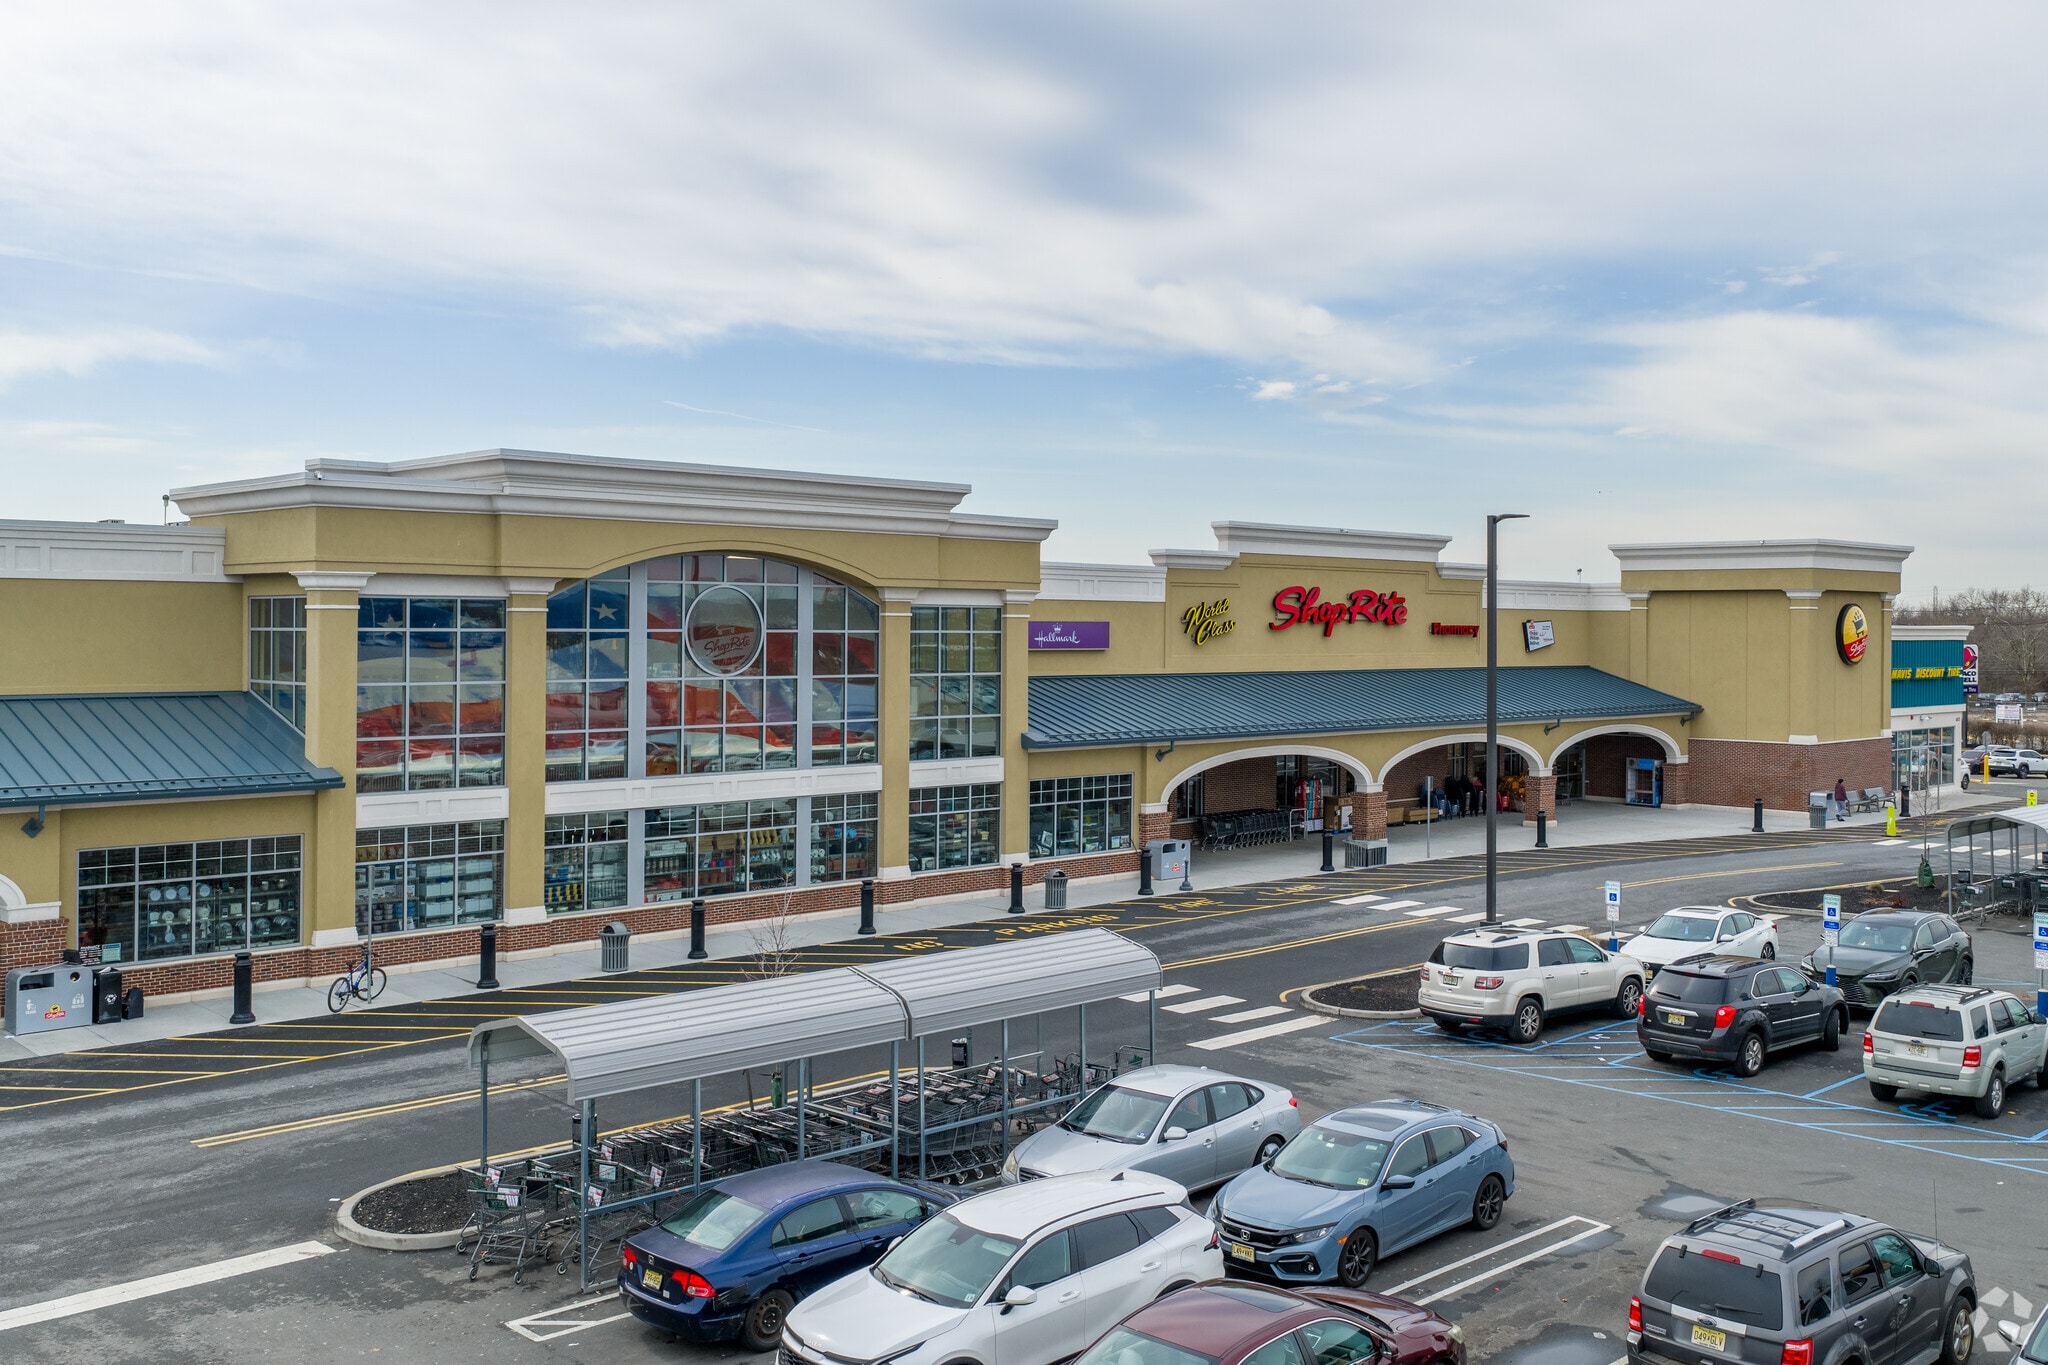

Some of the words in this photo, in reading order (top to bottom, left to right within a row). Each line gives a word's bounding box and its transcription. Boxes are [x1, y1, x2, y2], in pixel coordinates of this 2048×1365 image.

[1184, 598, 1230, 634] World
[1269, 586, 1408, 637] ShopRite
[1033, 630, 1081, 648] Hallmark
[1195, 618, 1236, 646] Class
[1432, 622, 1480, 638] Pharmacy
[704, 636, 751, 657] ShopRite
[1891, 669, 1912, 679] MAVIS
[1915, 668, 1945, 678] DISCOUNT
[1948, 667, 1961, 677] TIRE
[893, 940, 944, 951] NO
[994, 914, 1120, 936] PARKING
[1158, 898, 1225, 911] FIRE
[1257, 884, 1326, 896] LANE
